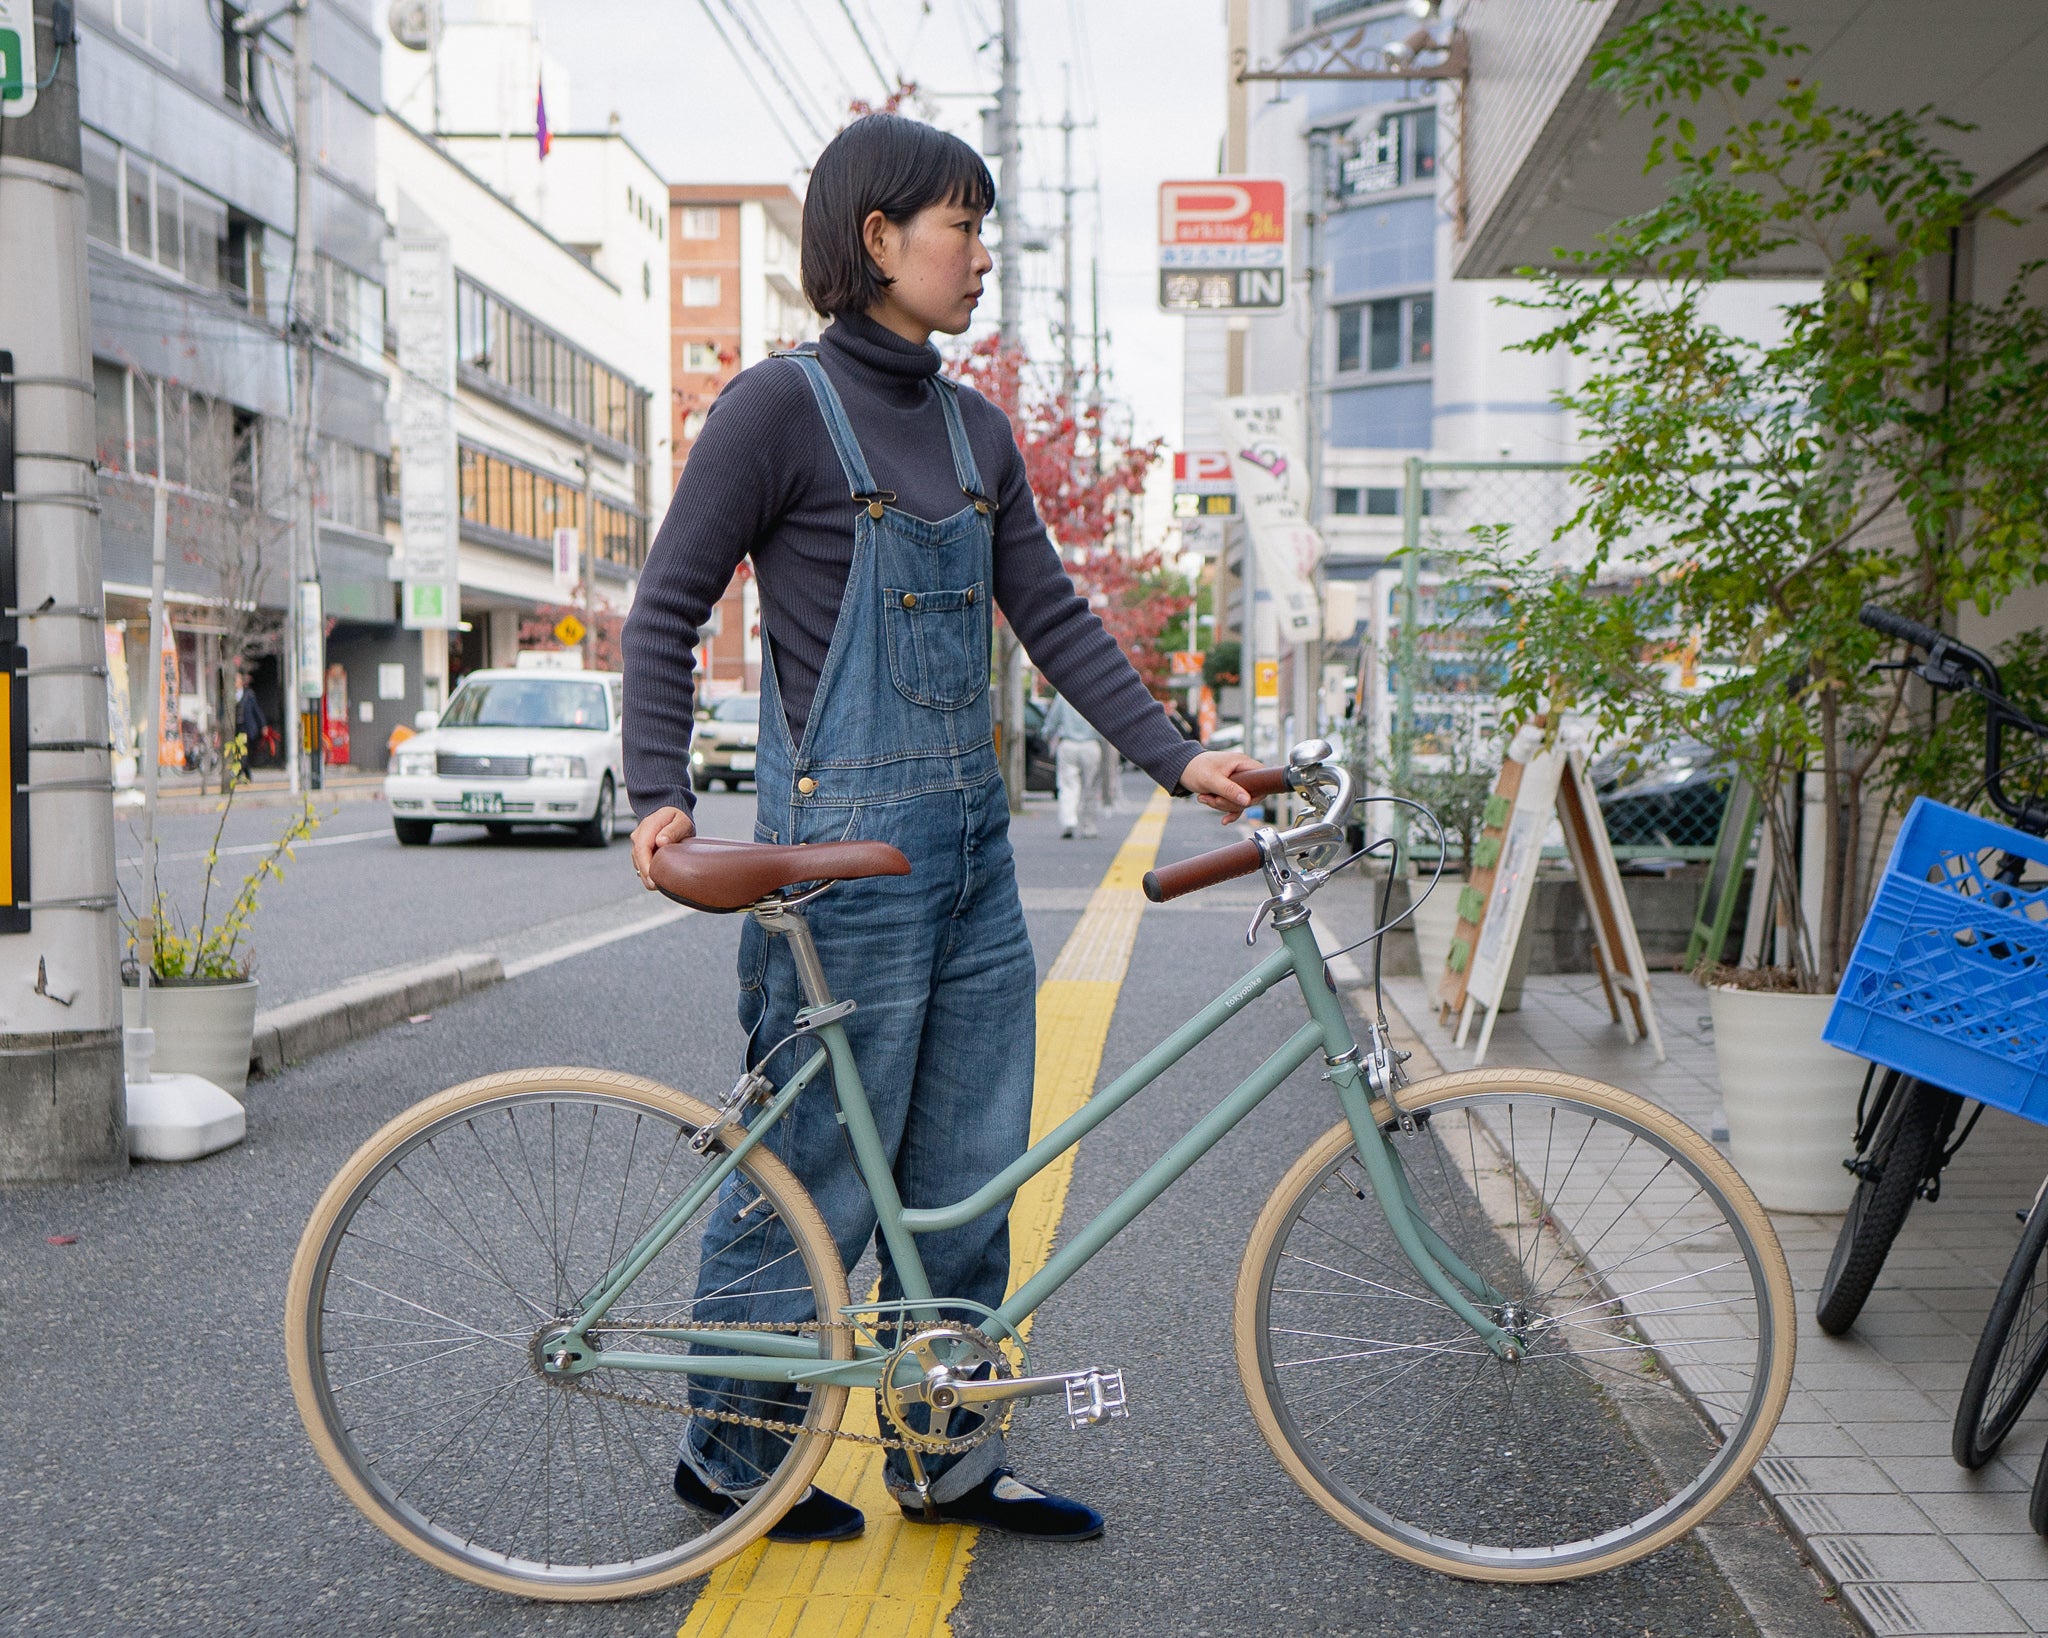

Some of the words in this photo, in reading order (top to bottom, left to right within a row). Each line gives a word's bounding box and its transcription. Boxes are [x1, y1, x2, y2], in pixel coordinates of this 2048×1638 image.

[1239, 270, 1281, 304] IN
[1186, 453, 1228, 480] P
[1226, 977, 1262, 1007] tokyobike
